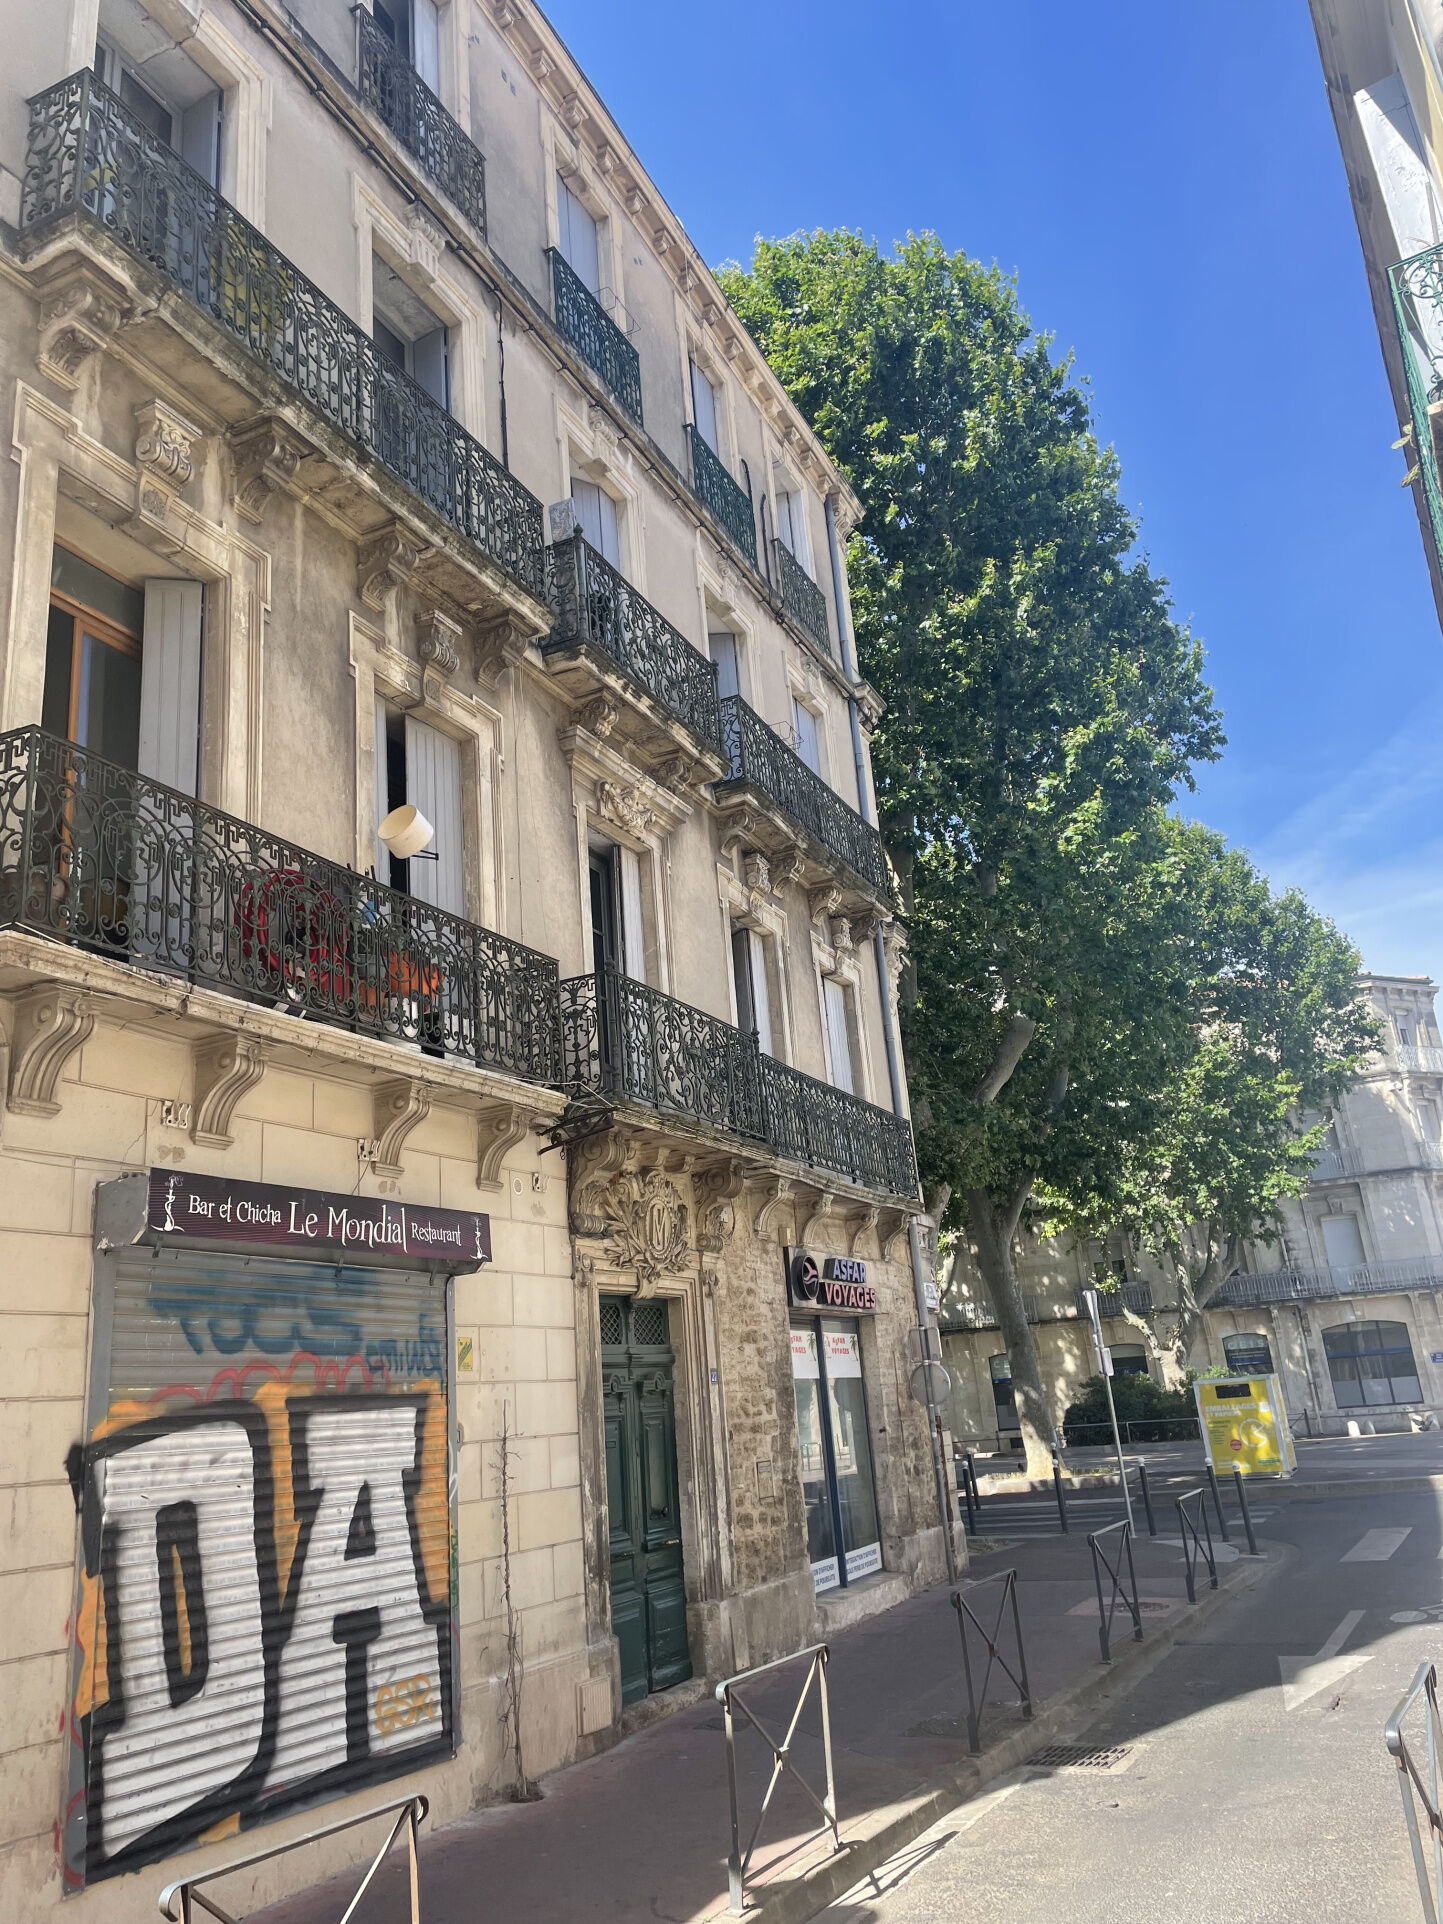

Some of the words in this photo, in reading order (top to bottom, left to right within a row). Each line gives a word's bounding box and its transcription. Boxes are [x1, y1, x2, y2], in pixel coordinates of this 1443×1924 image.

[188, 1194, 215, 1218] Bar
[219, 1195, 232, 1219] et
[236, 1201, 281, 1226] Chicha
[287, 1201, 318, 1237] Le
[327, 1204, 408, 1253] Mondial
[410, 1222, 462, 1247] Restaurant
[833, 1258, 866, 1283] ASFAR
[825, 1283, 875, 1308] VOYAGES
